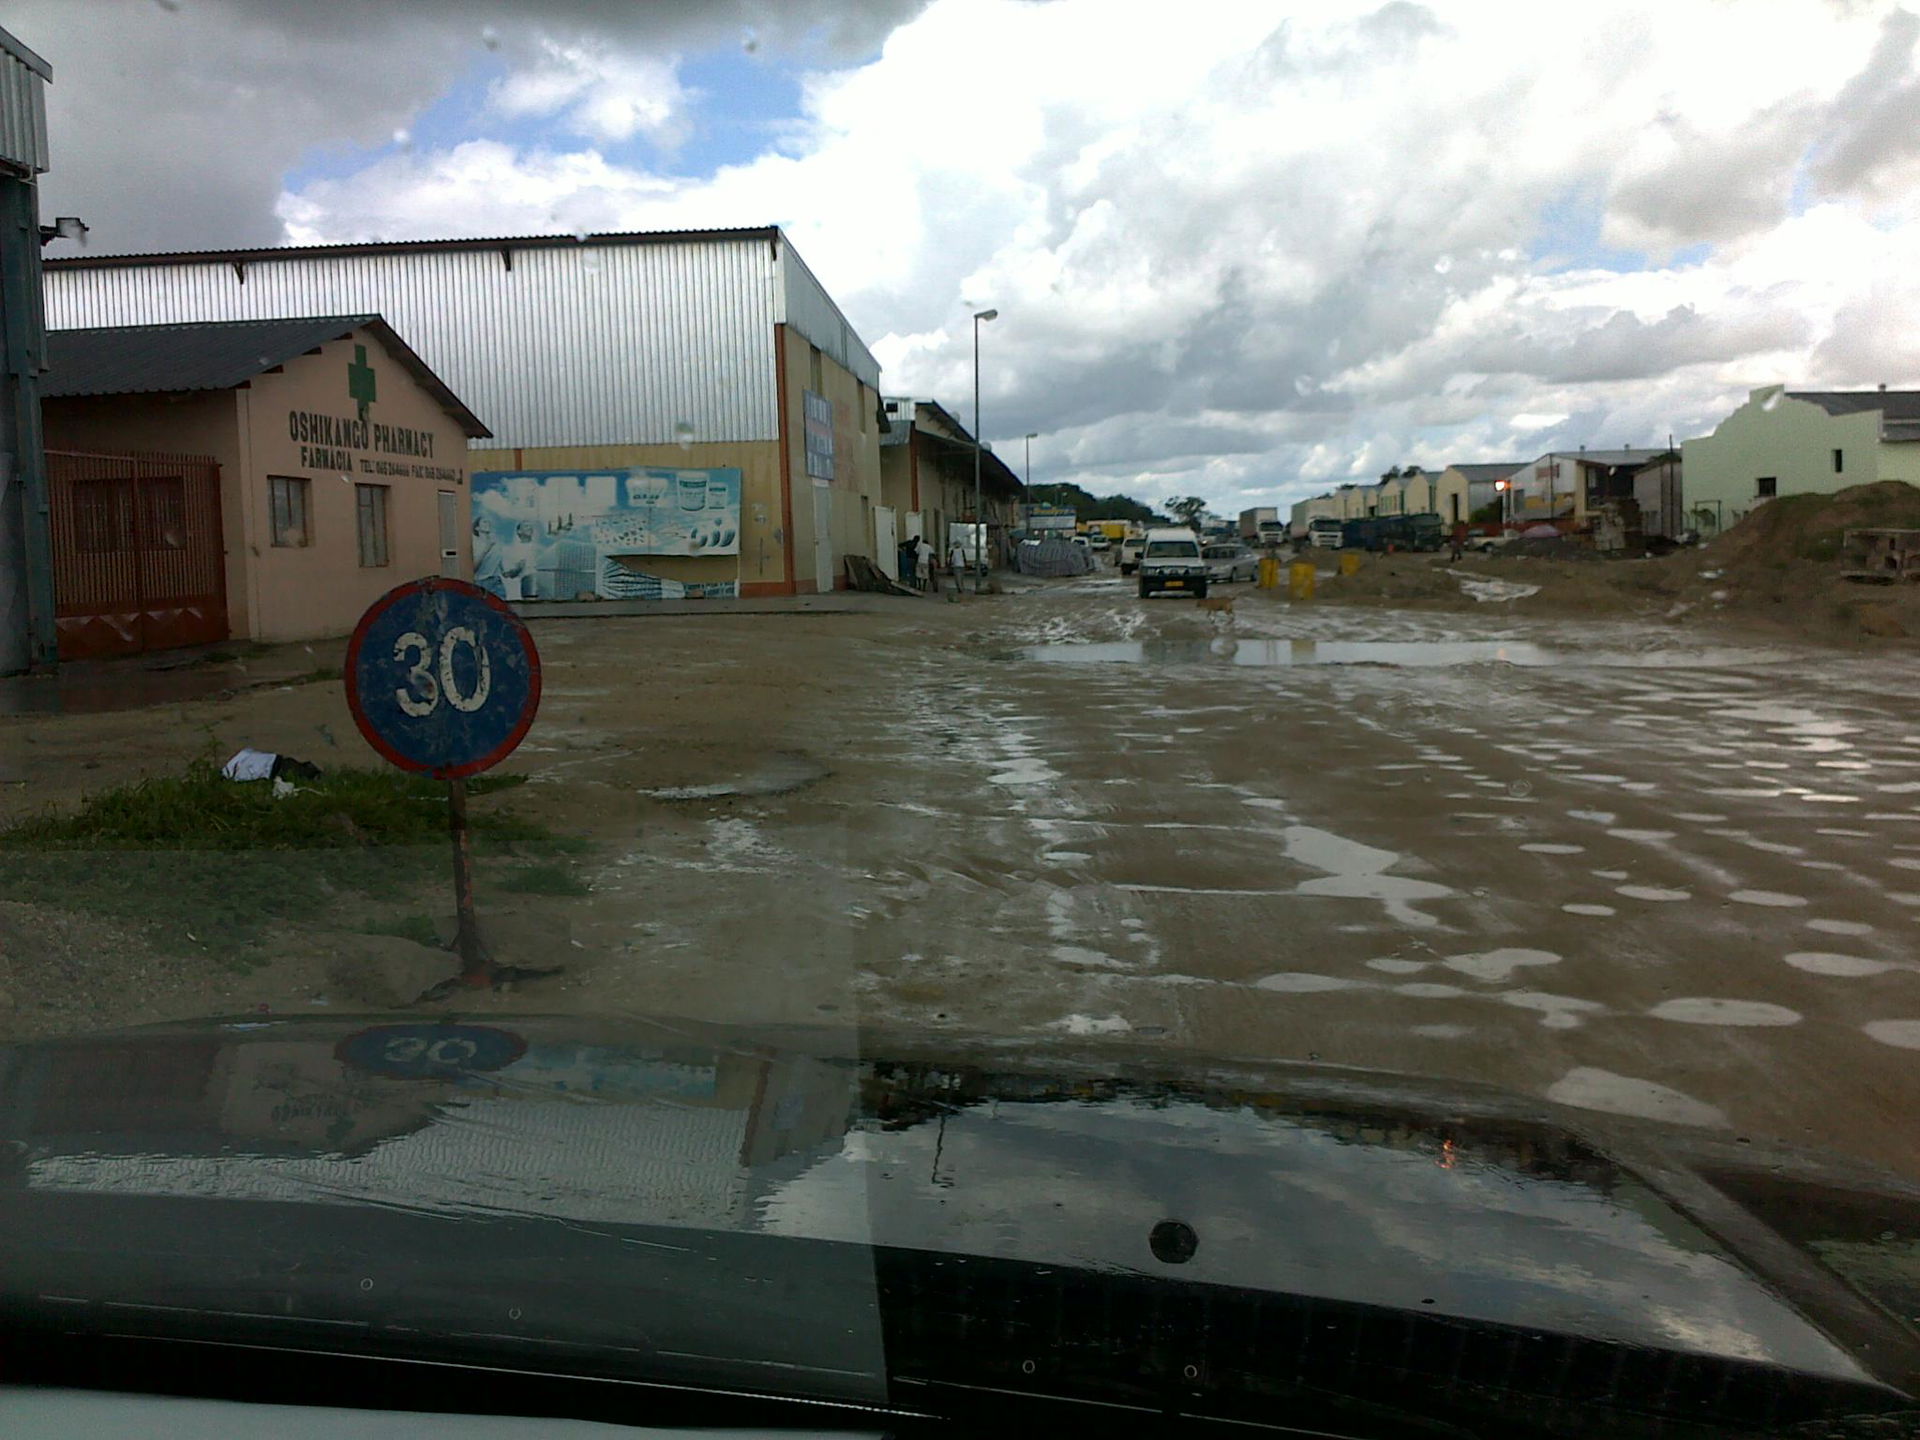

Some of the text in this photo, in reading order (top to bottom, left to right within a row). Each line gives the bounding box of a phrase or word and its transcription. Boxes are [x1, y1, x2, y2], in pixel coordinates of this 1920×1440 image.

[289, 410, 435, 459] OSHIKANGO PHARMACY
[300, 446, 353, 473] FARMACIA
[393, 626, 491, 717] 30
